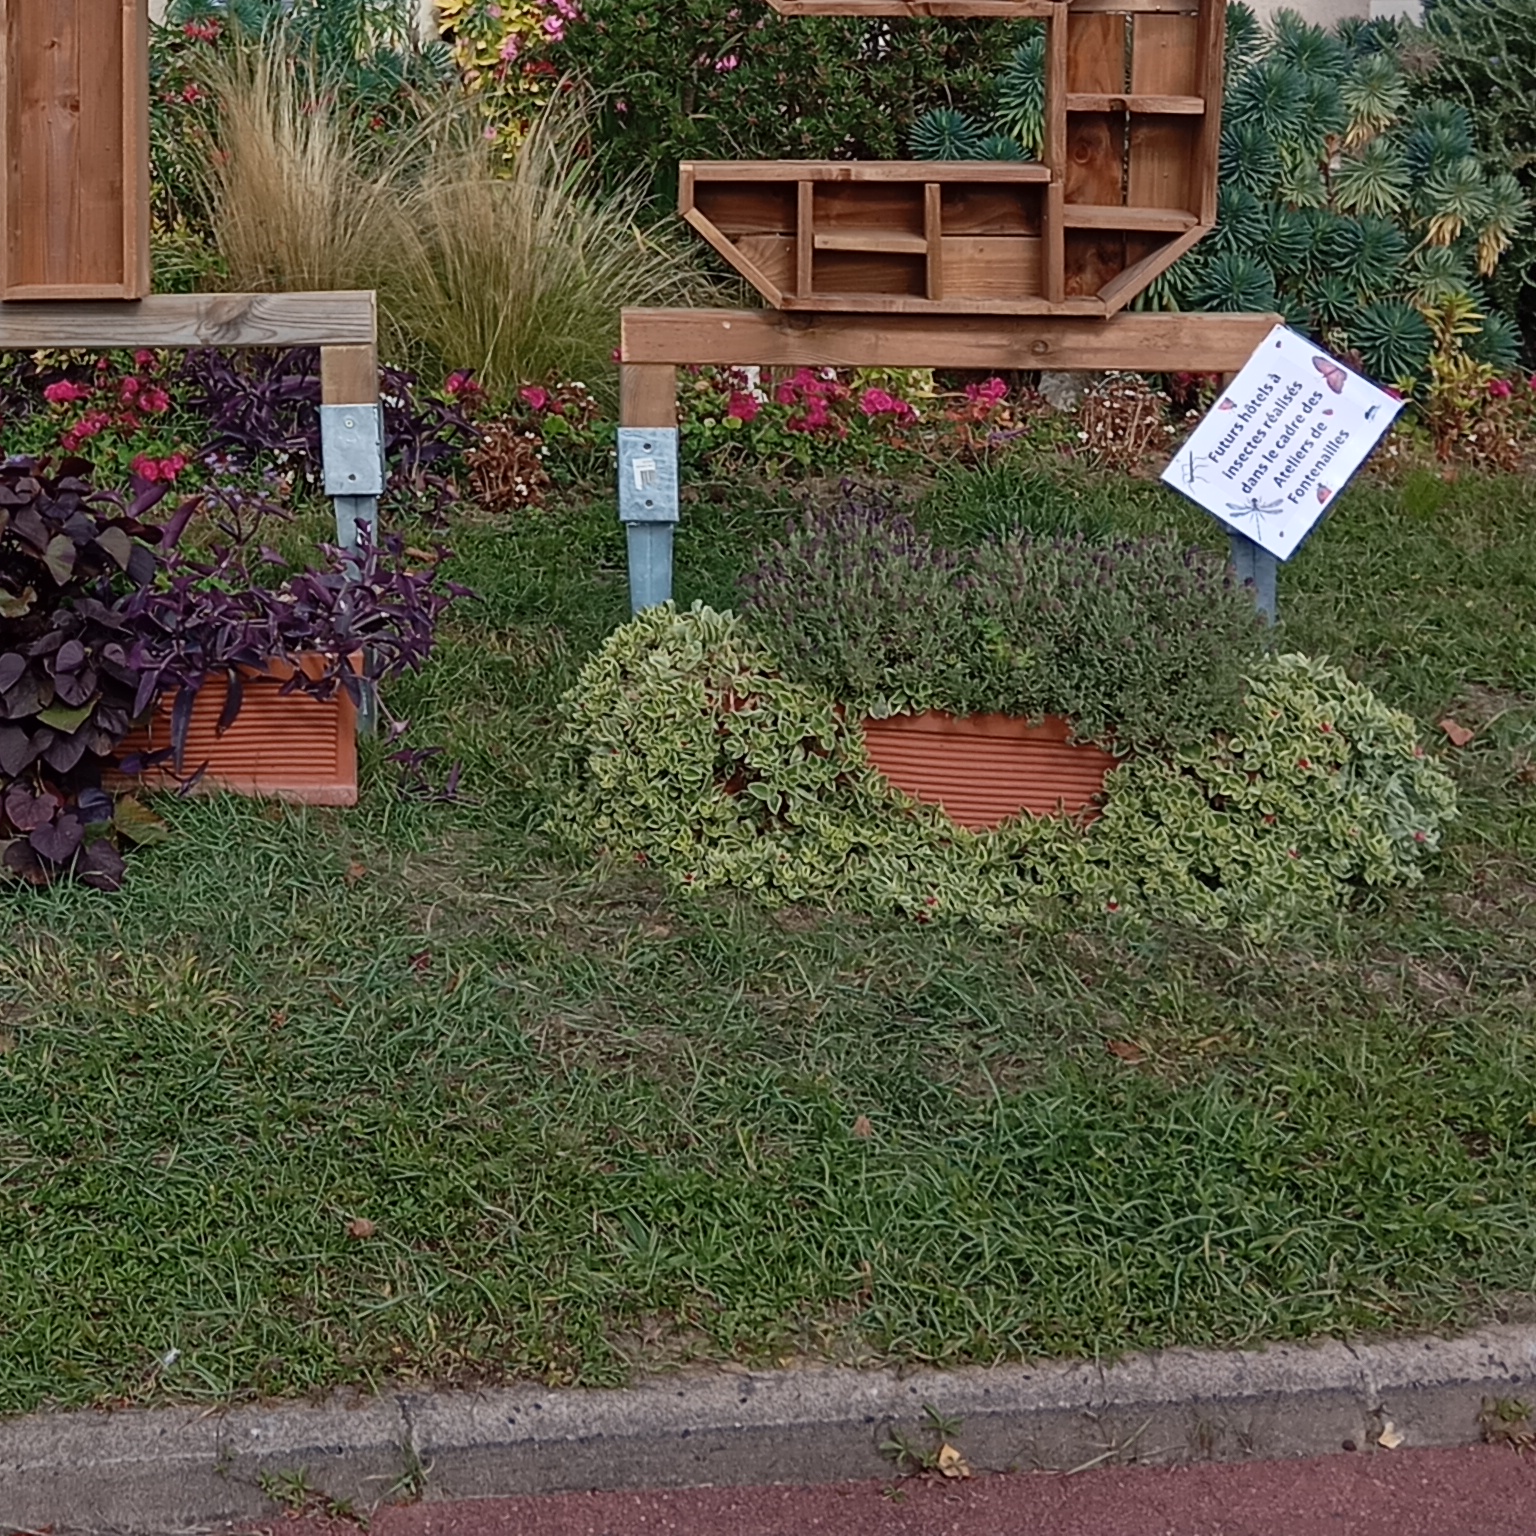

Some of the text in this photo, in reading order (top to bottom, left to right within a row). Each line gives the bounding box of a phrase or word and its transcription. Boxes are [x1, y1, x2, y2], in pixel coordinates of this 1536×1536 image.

[1208, 373, 1281, 464] Futurs hôtels à
[1221, 381, 1303, 480] insectes réalisés
[1241, 390, 1323, 494] dans le cadre des
[1273, 421, 1328, 489] Ateliers de
[1287, 429, 1350, 505] Fontenailles
